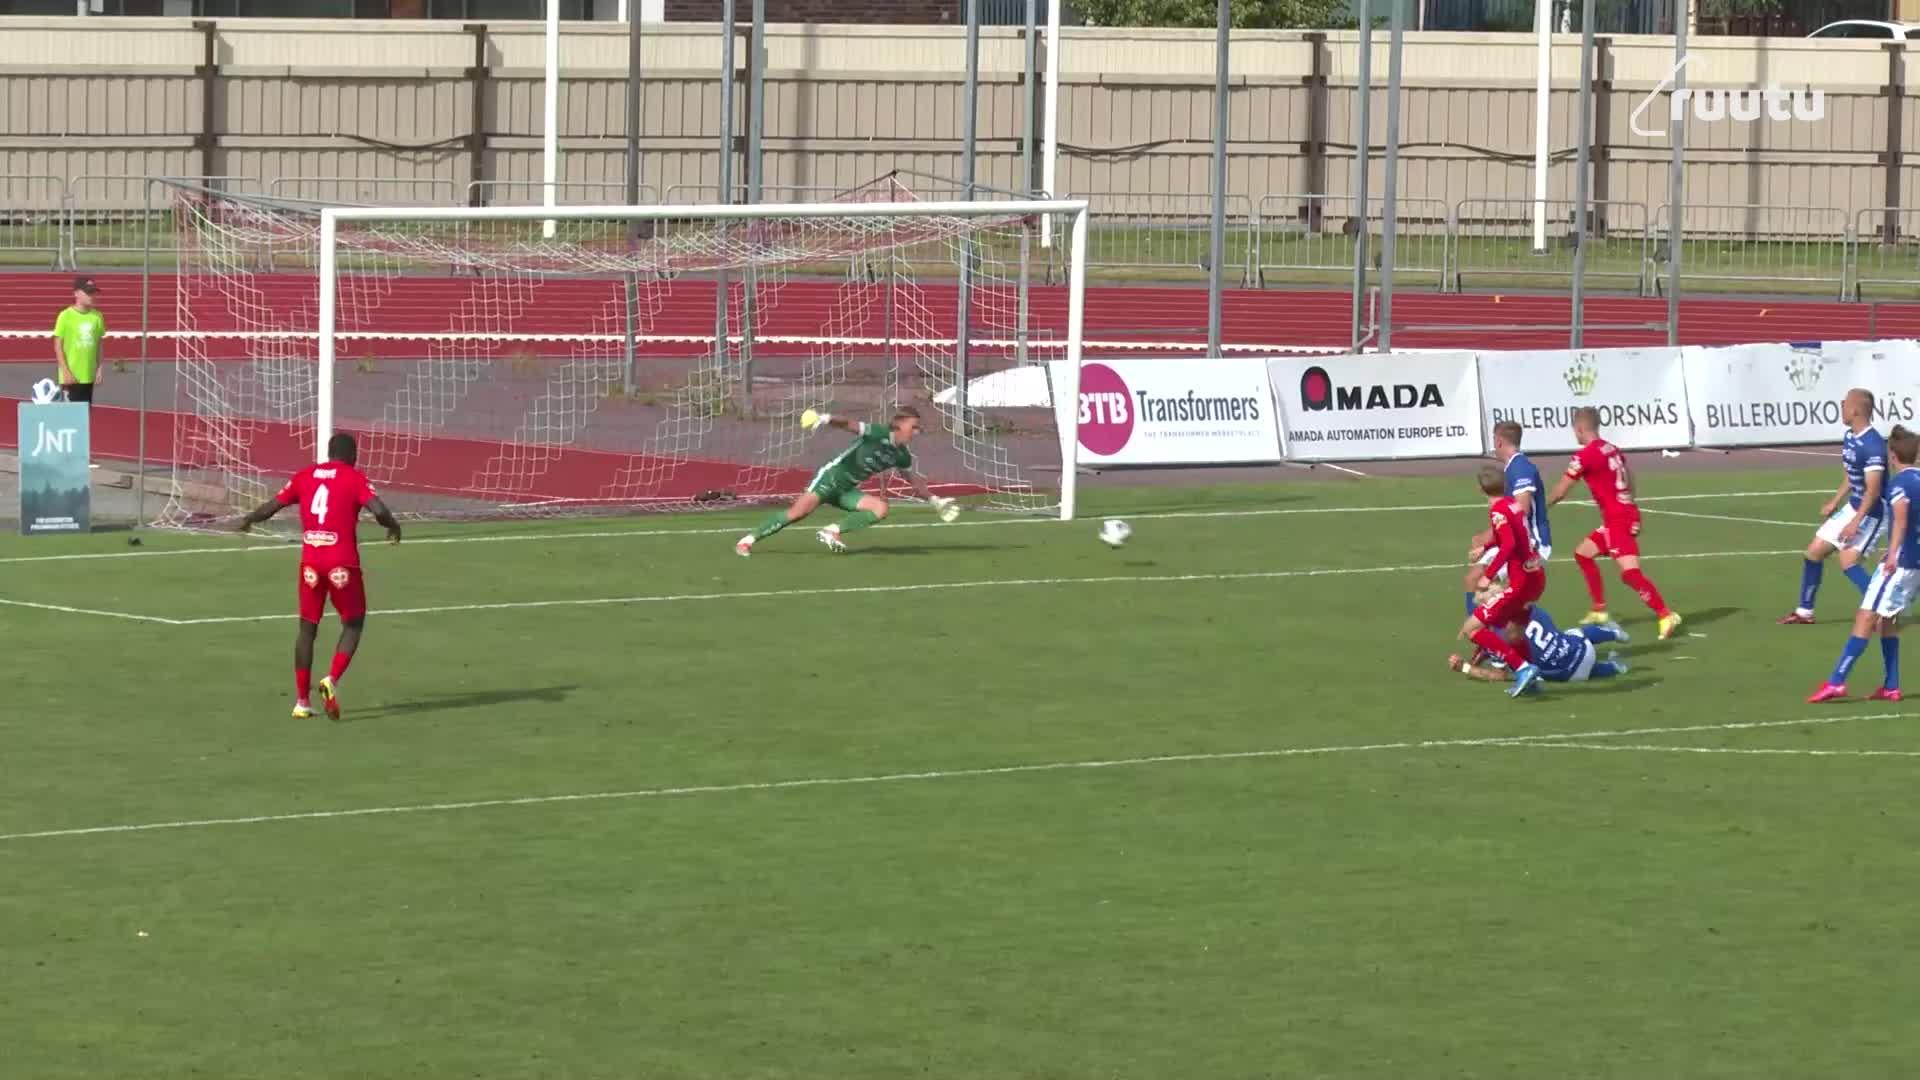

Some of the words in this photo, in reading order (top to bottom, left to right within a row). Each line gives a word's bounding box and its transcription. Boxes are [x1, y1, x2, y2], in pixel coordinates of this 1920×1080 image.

[1136, 389, 1260, 422] Transformers
[1301, 366, 1444, 411] AMADA
[1079, 391, 1129, 425] BTB
[1706, 391, 1914, 429] BILLERUDKONÄS
[32, 421, 78, 457] JNT
[1289, 430, 1325, 442] AMADA
[1327, 428, 1395, 441] AUTOMATION
[1398, 426, 1443, 439] EUROPE
[1446, 425, 1469, 437] LTD.
[310, 483, 329, 525] 4
[1525, 619, 1554, 651] 2
